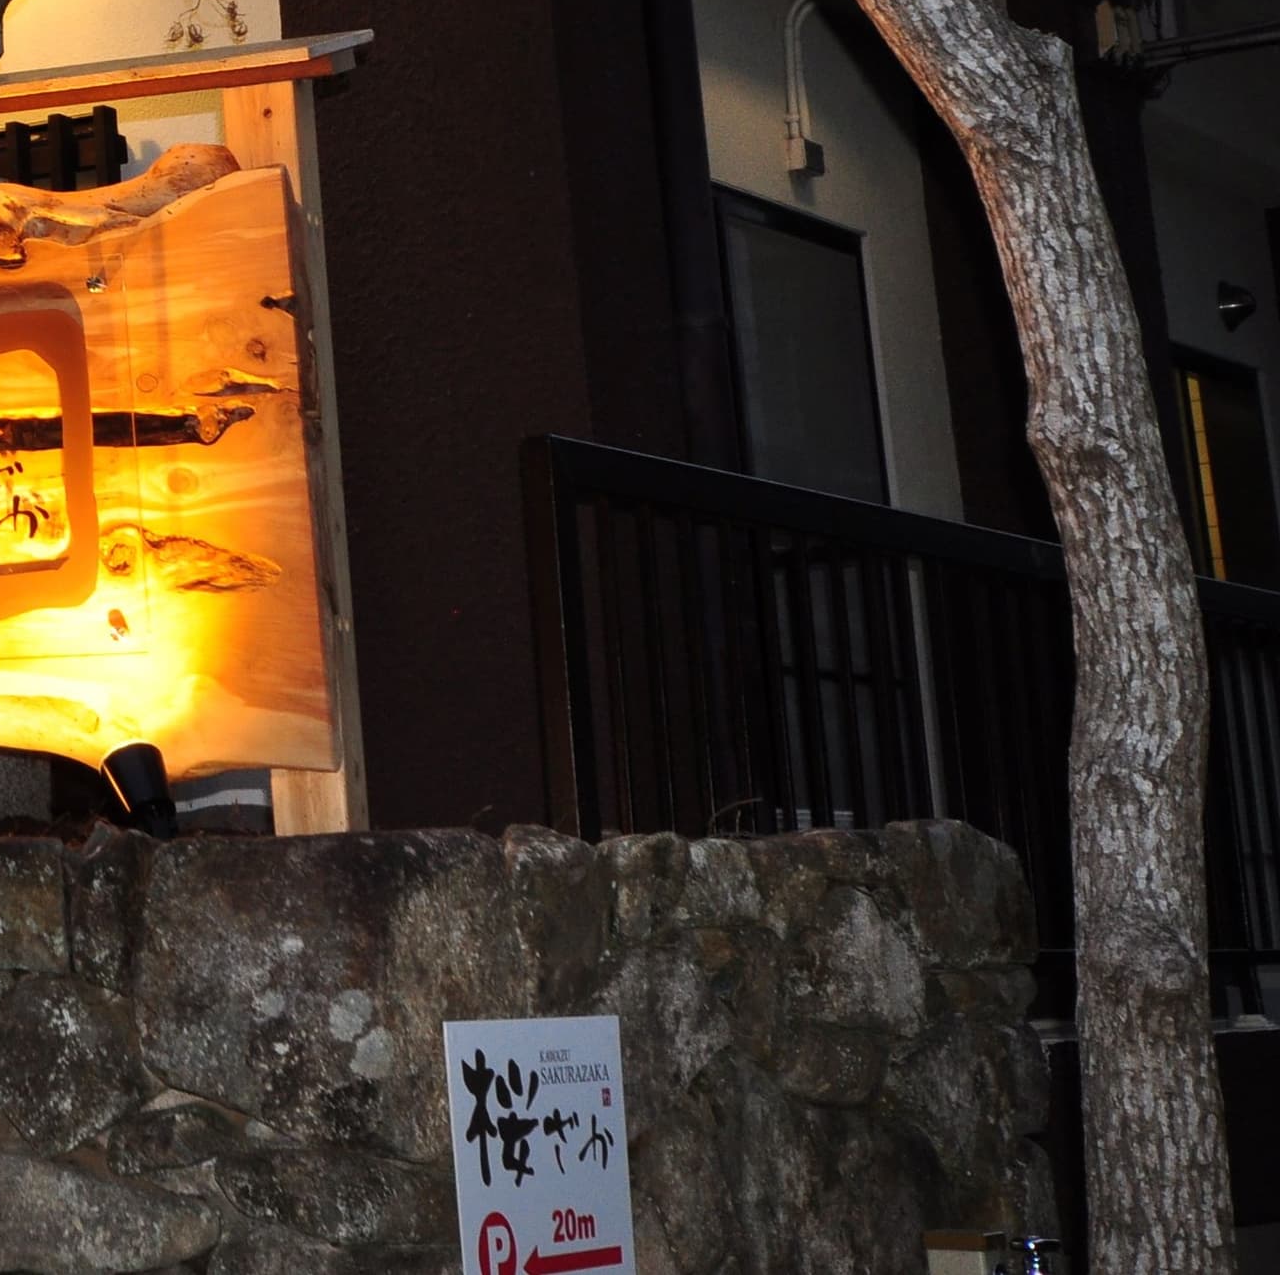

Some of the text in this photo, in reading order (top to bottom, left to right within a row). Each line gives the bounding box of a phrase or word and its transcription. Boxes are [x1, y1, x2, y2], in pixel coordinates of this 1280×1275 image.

[540, 1064, 610, 1085] SAKURAZAKA
[461, 1048, 614, 1187] 桜ざか
[552, 1208, 596, 1243] 20m
